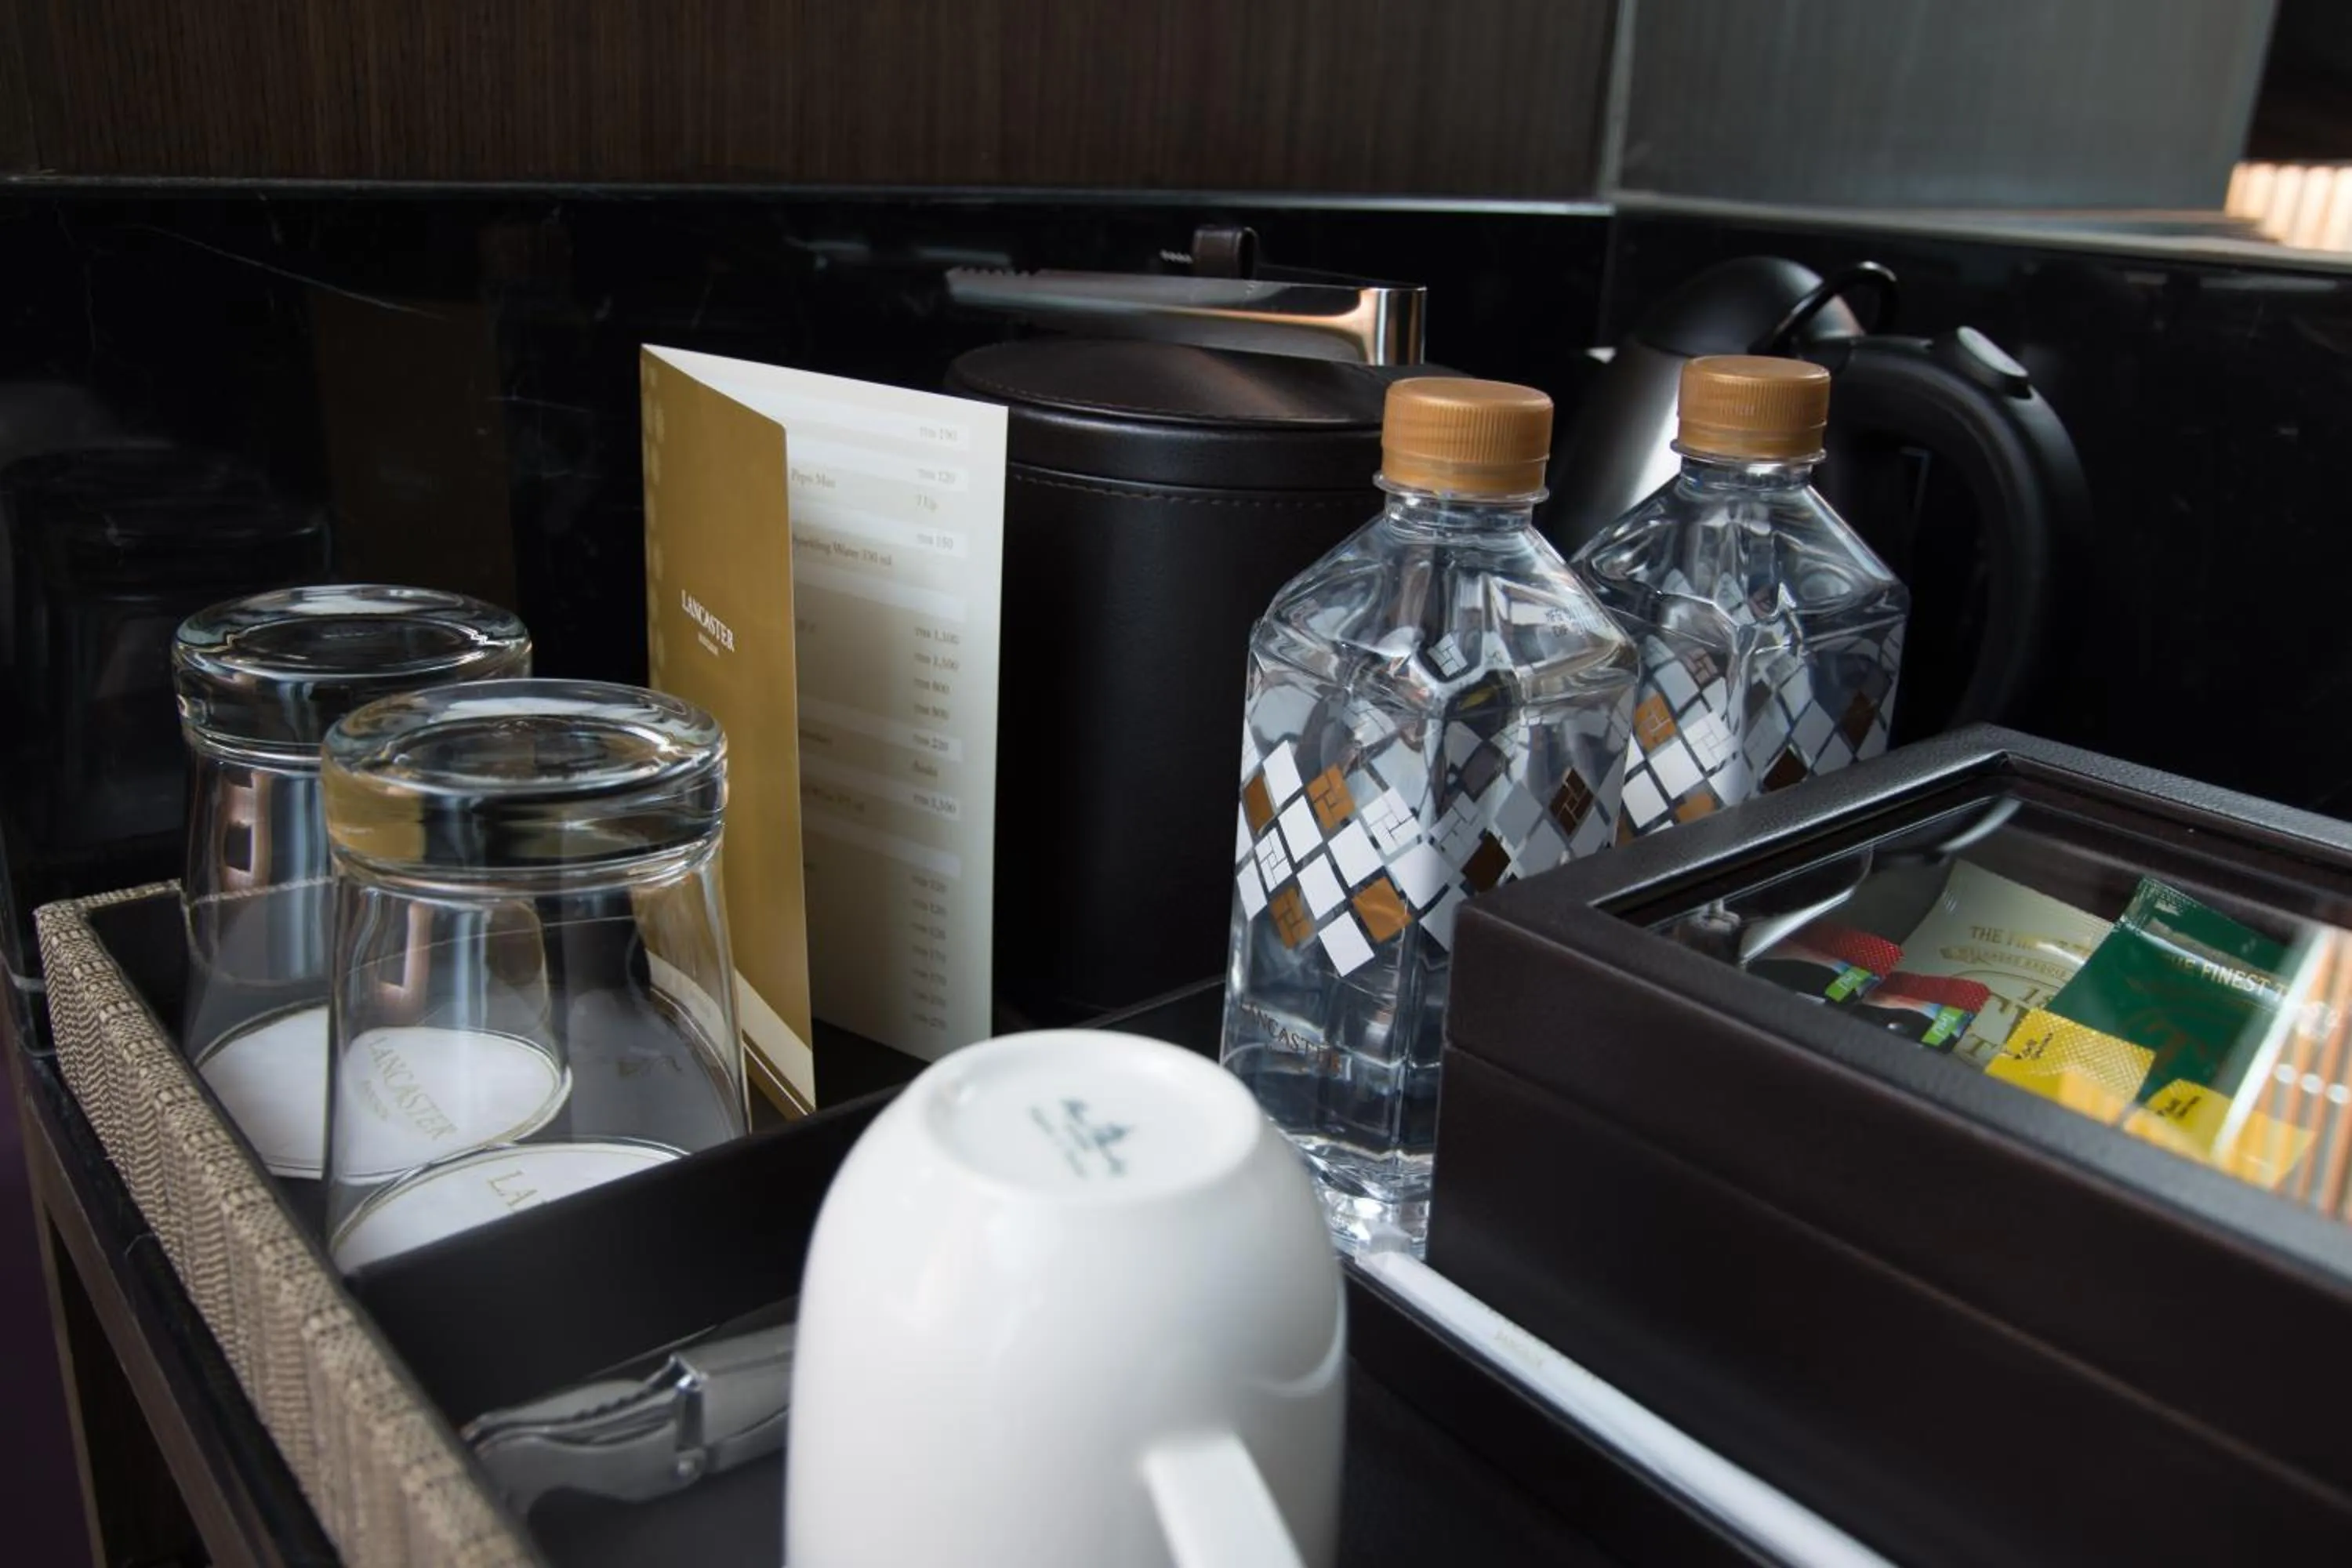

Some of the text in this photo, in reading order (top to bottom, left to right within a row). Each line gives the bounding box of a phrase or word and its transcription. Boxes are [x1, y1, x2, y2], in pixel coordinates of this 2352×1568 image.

[681, 589, 735, 652] LANCASTER
[1969, 925, 2003, 944] THE
[2201, 960, 2271, 998] FINEST
[368, 1036, 457, 1142] LANCASTER
